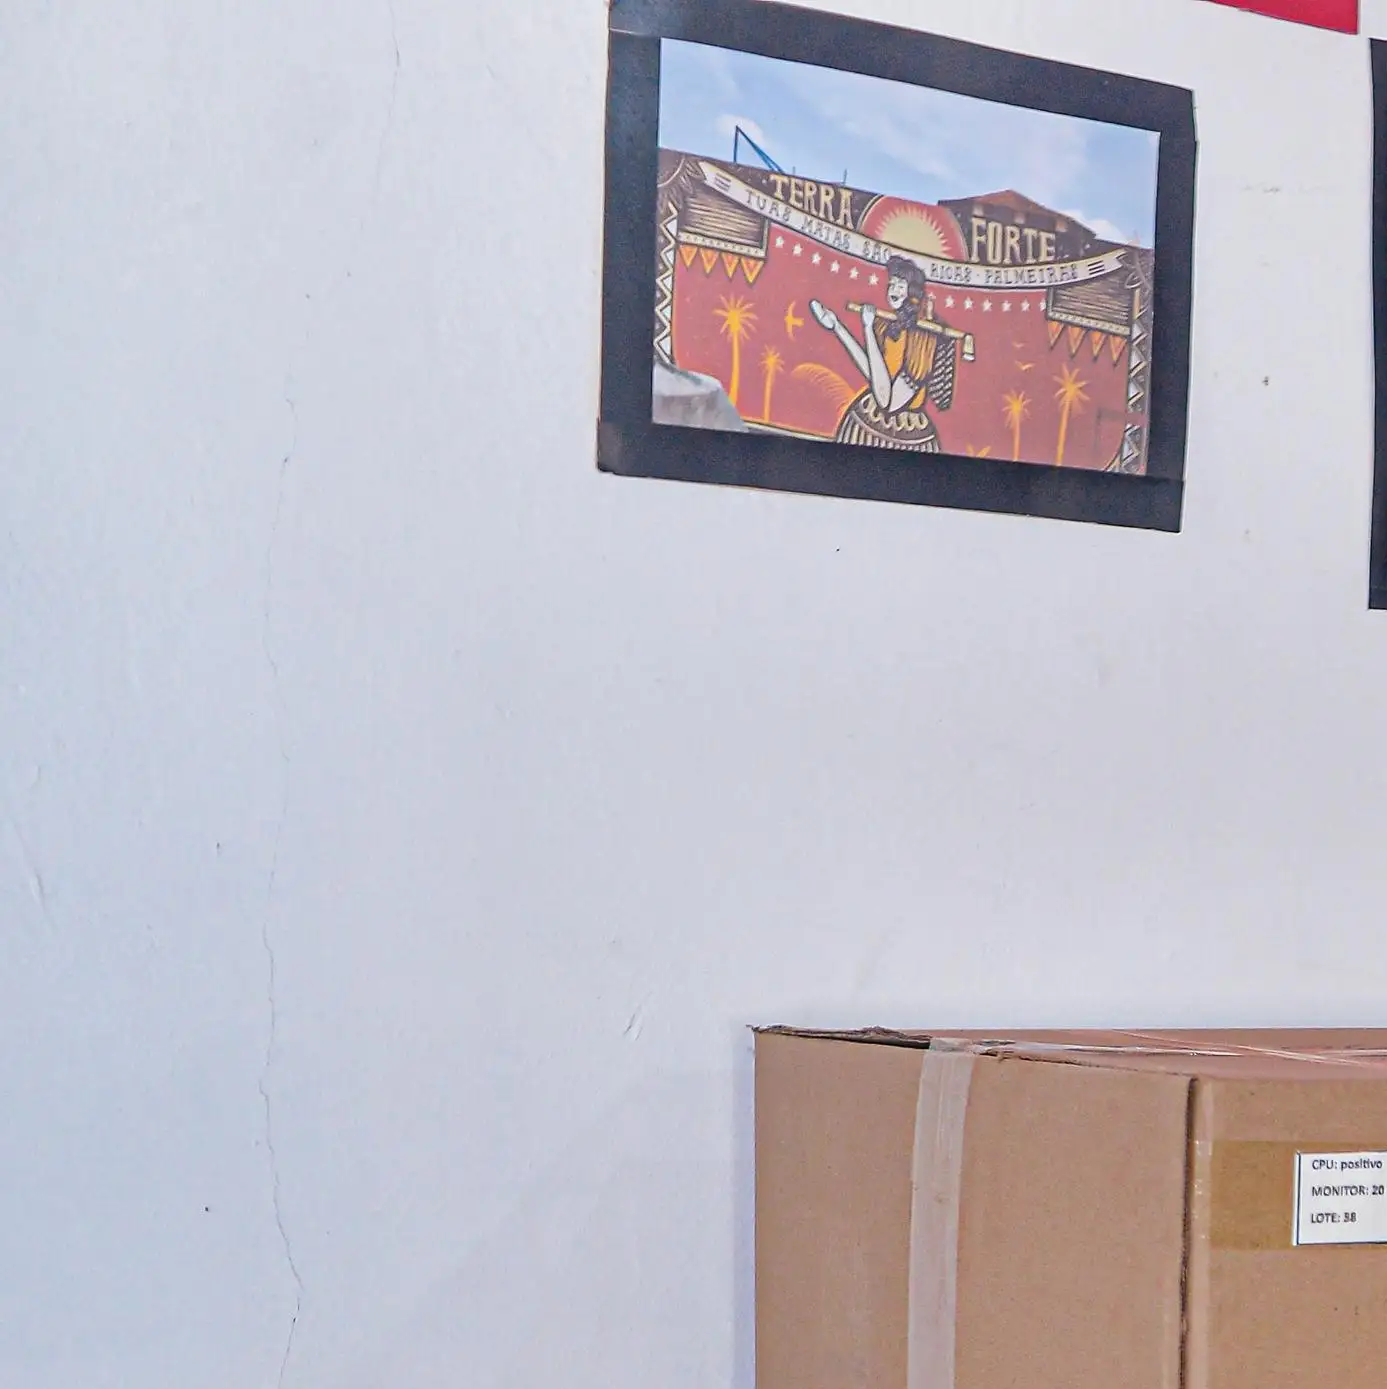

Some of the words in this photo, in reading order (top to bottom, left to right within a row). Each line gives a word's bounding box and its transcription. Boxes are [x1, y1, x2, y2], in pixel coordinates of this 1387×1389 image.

[769, 174, 854, 231] TERRA
[969, 216, 1056, 265] FORTE
[1312, 1159, 1338, 1170] CPU:
[1340, 1158, 1382, 1171] positivo
[1311, 1185, 1369, 1197] MONITOR:
[1372, 1185, 1385, 1196] 20
[1311, 1212, 1341, 1224] LOTE:
